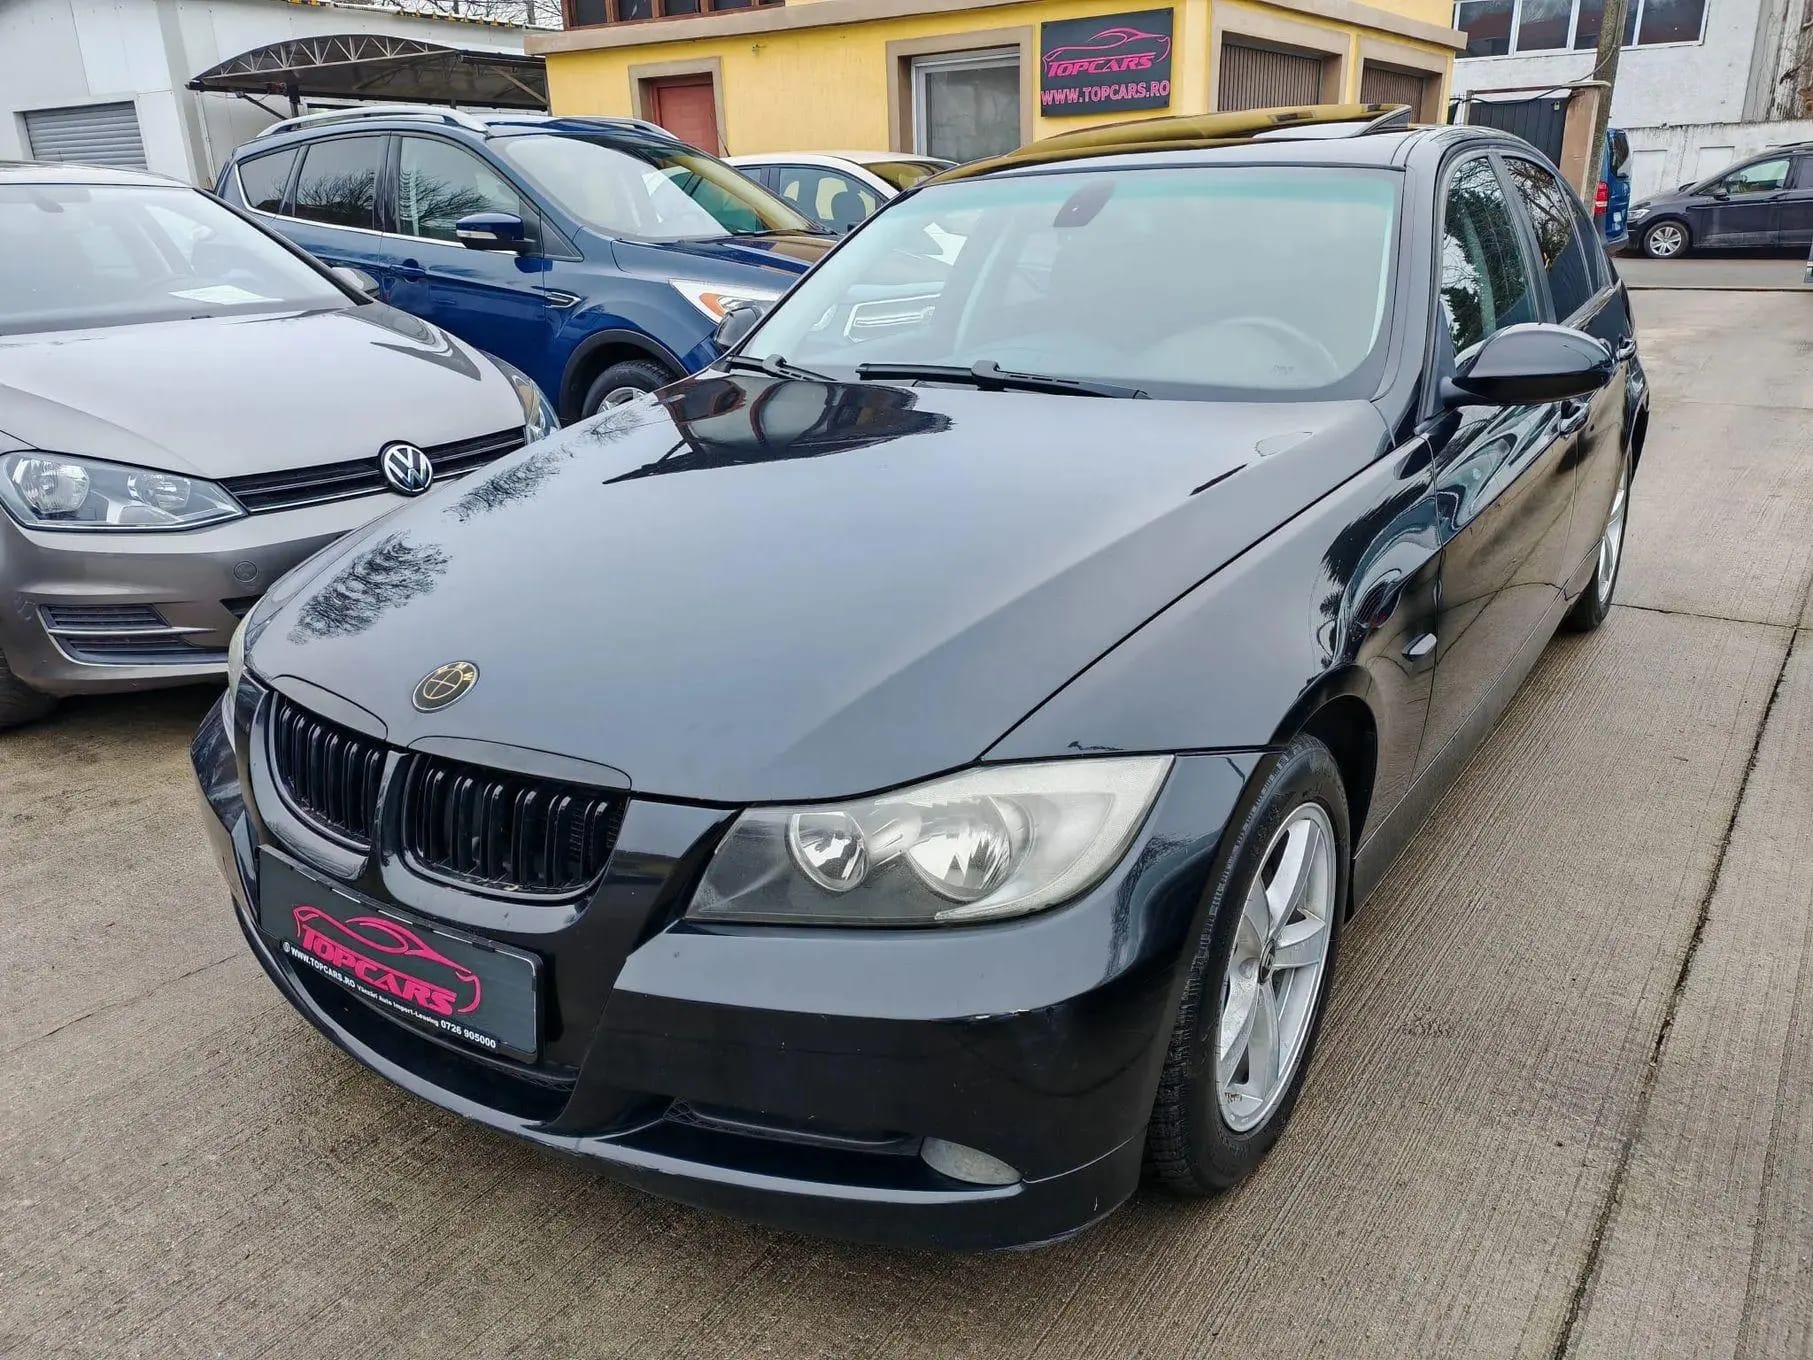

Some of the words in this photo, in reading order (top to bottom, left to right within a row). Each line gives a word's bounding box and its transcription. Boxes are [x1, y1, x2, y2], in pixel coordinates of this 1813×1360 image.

[1041, 80, 1170, 106] WWW.TOPCARS.RO
[1048, 52, 1156, 78] TOPCARS
[290, 946, 356, 988] WWW.TOPCARS.RO
[440, 1019, 462, 1035] 0726
[463, 1028, 497, 1049] 905000
[301, 923, 457, 1016] TOPCARS
